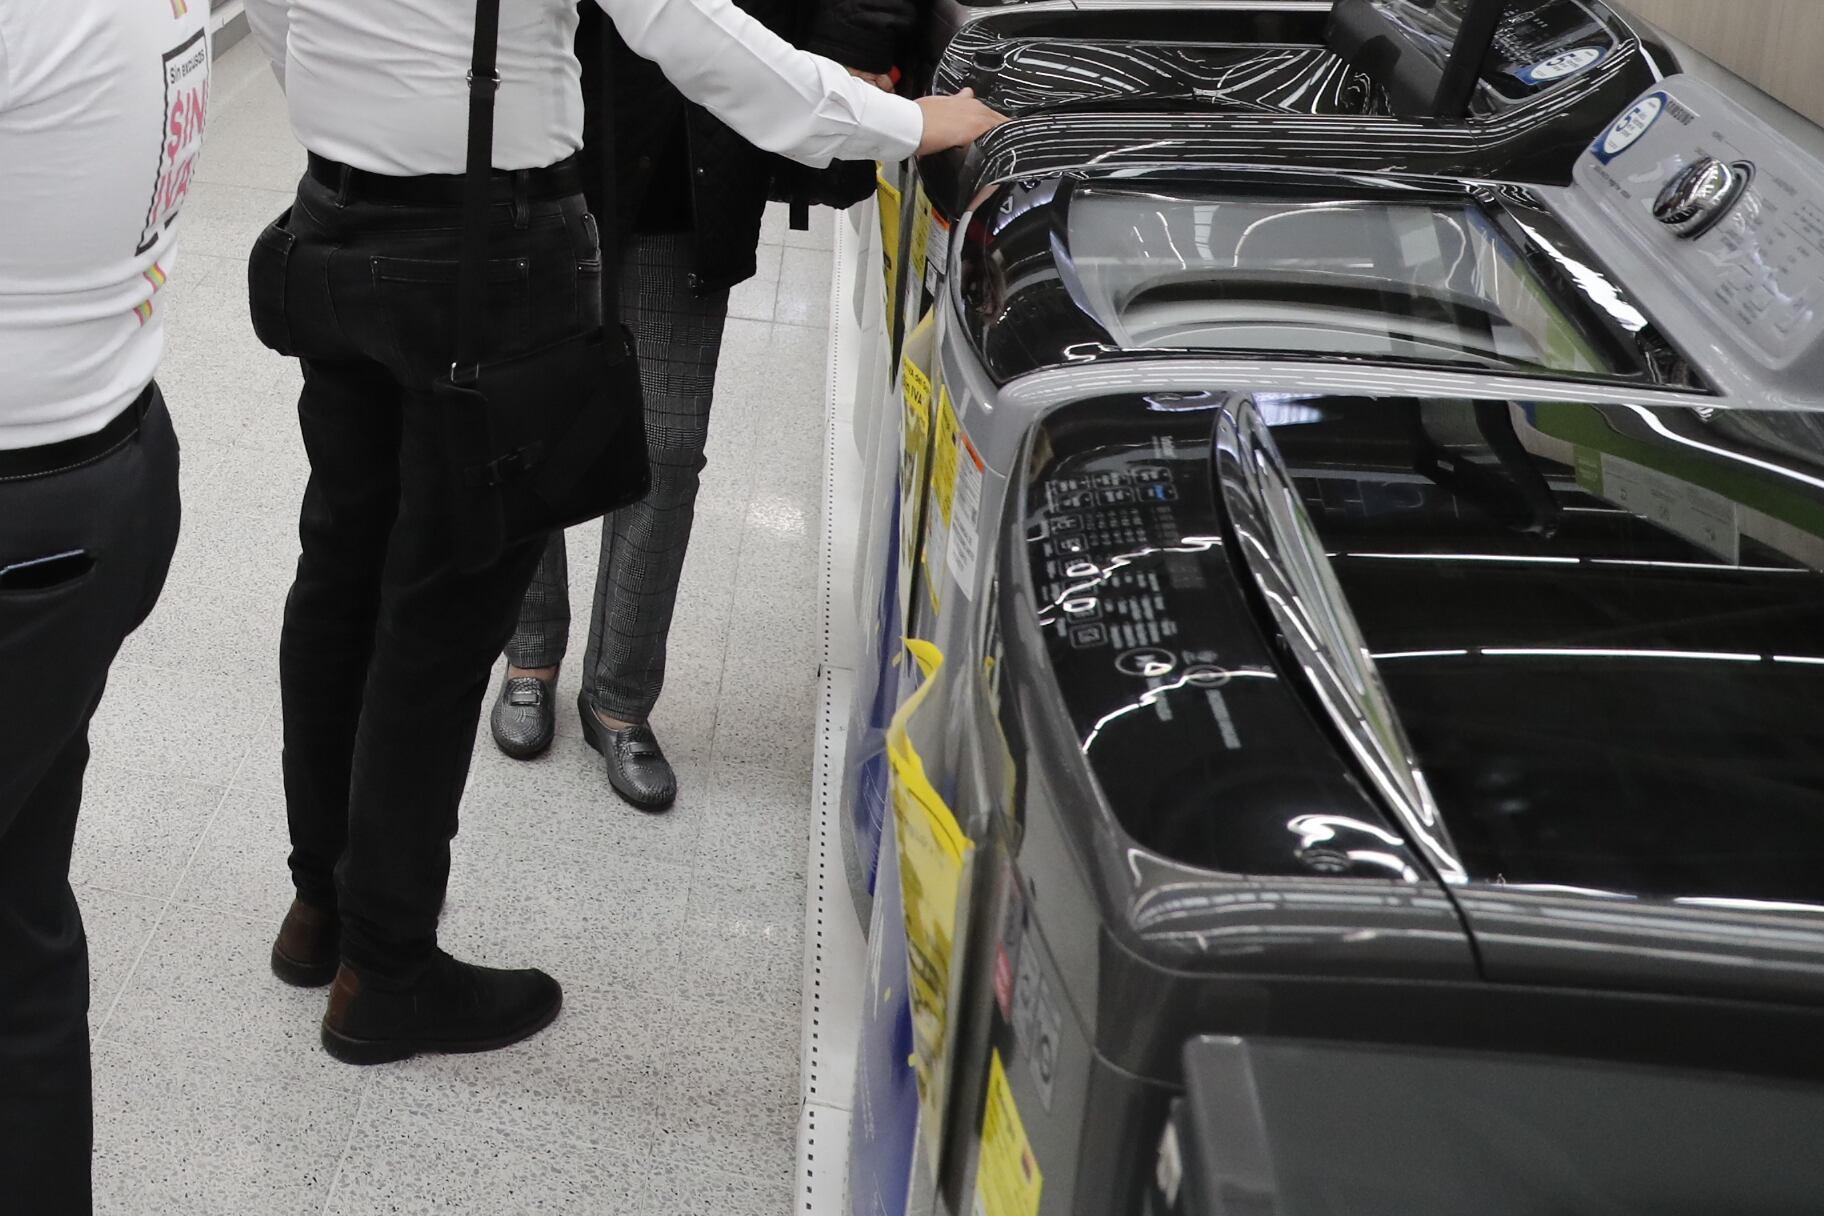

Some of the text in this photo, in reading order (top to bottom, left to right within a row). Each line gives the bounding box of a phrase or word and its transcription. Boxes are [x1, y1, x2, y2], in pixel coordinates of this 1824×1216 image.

[169, 49, 206, 84] Sin excusas
[167, 79, 206, 167] $IN
[151, 152, 196, 225] IVA
